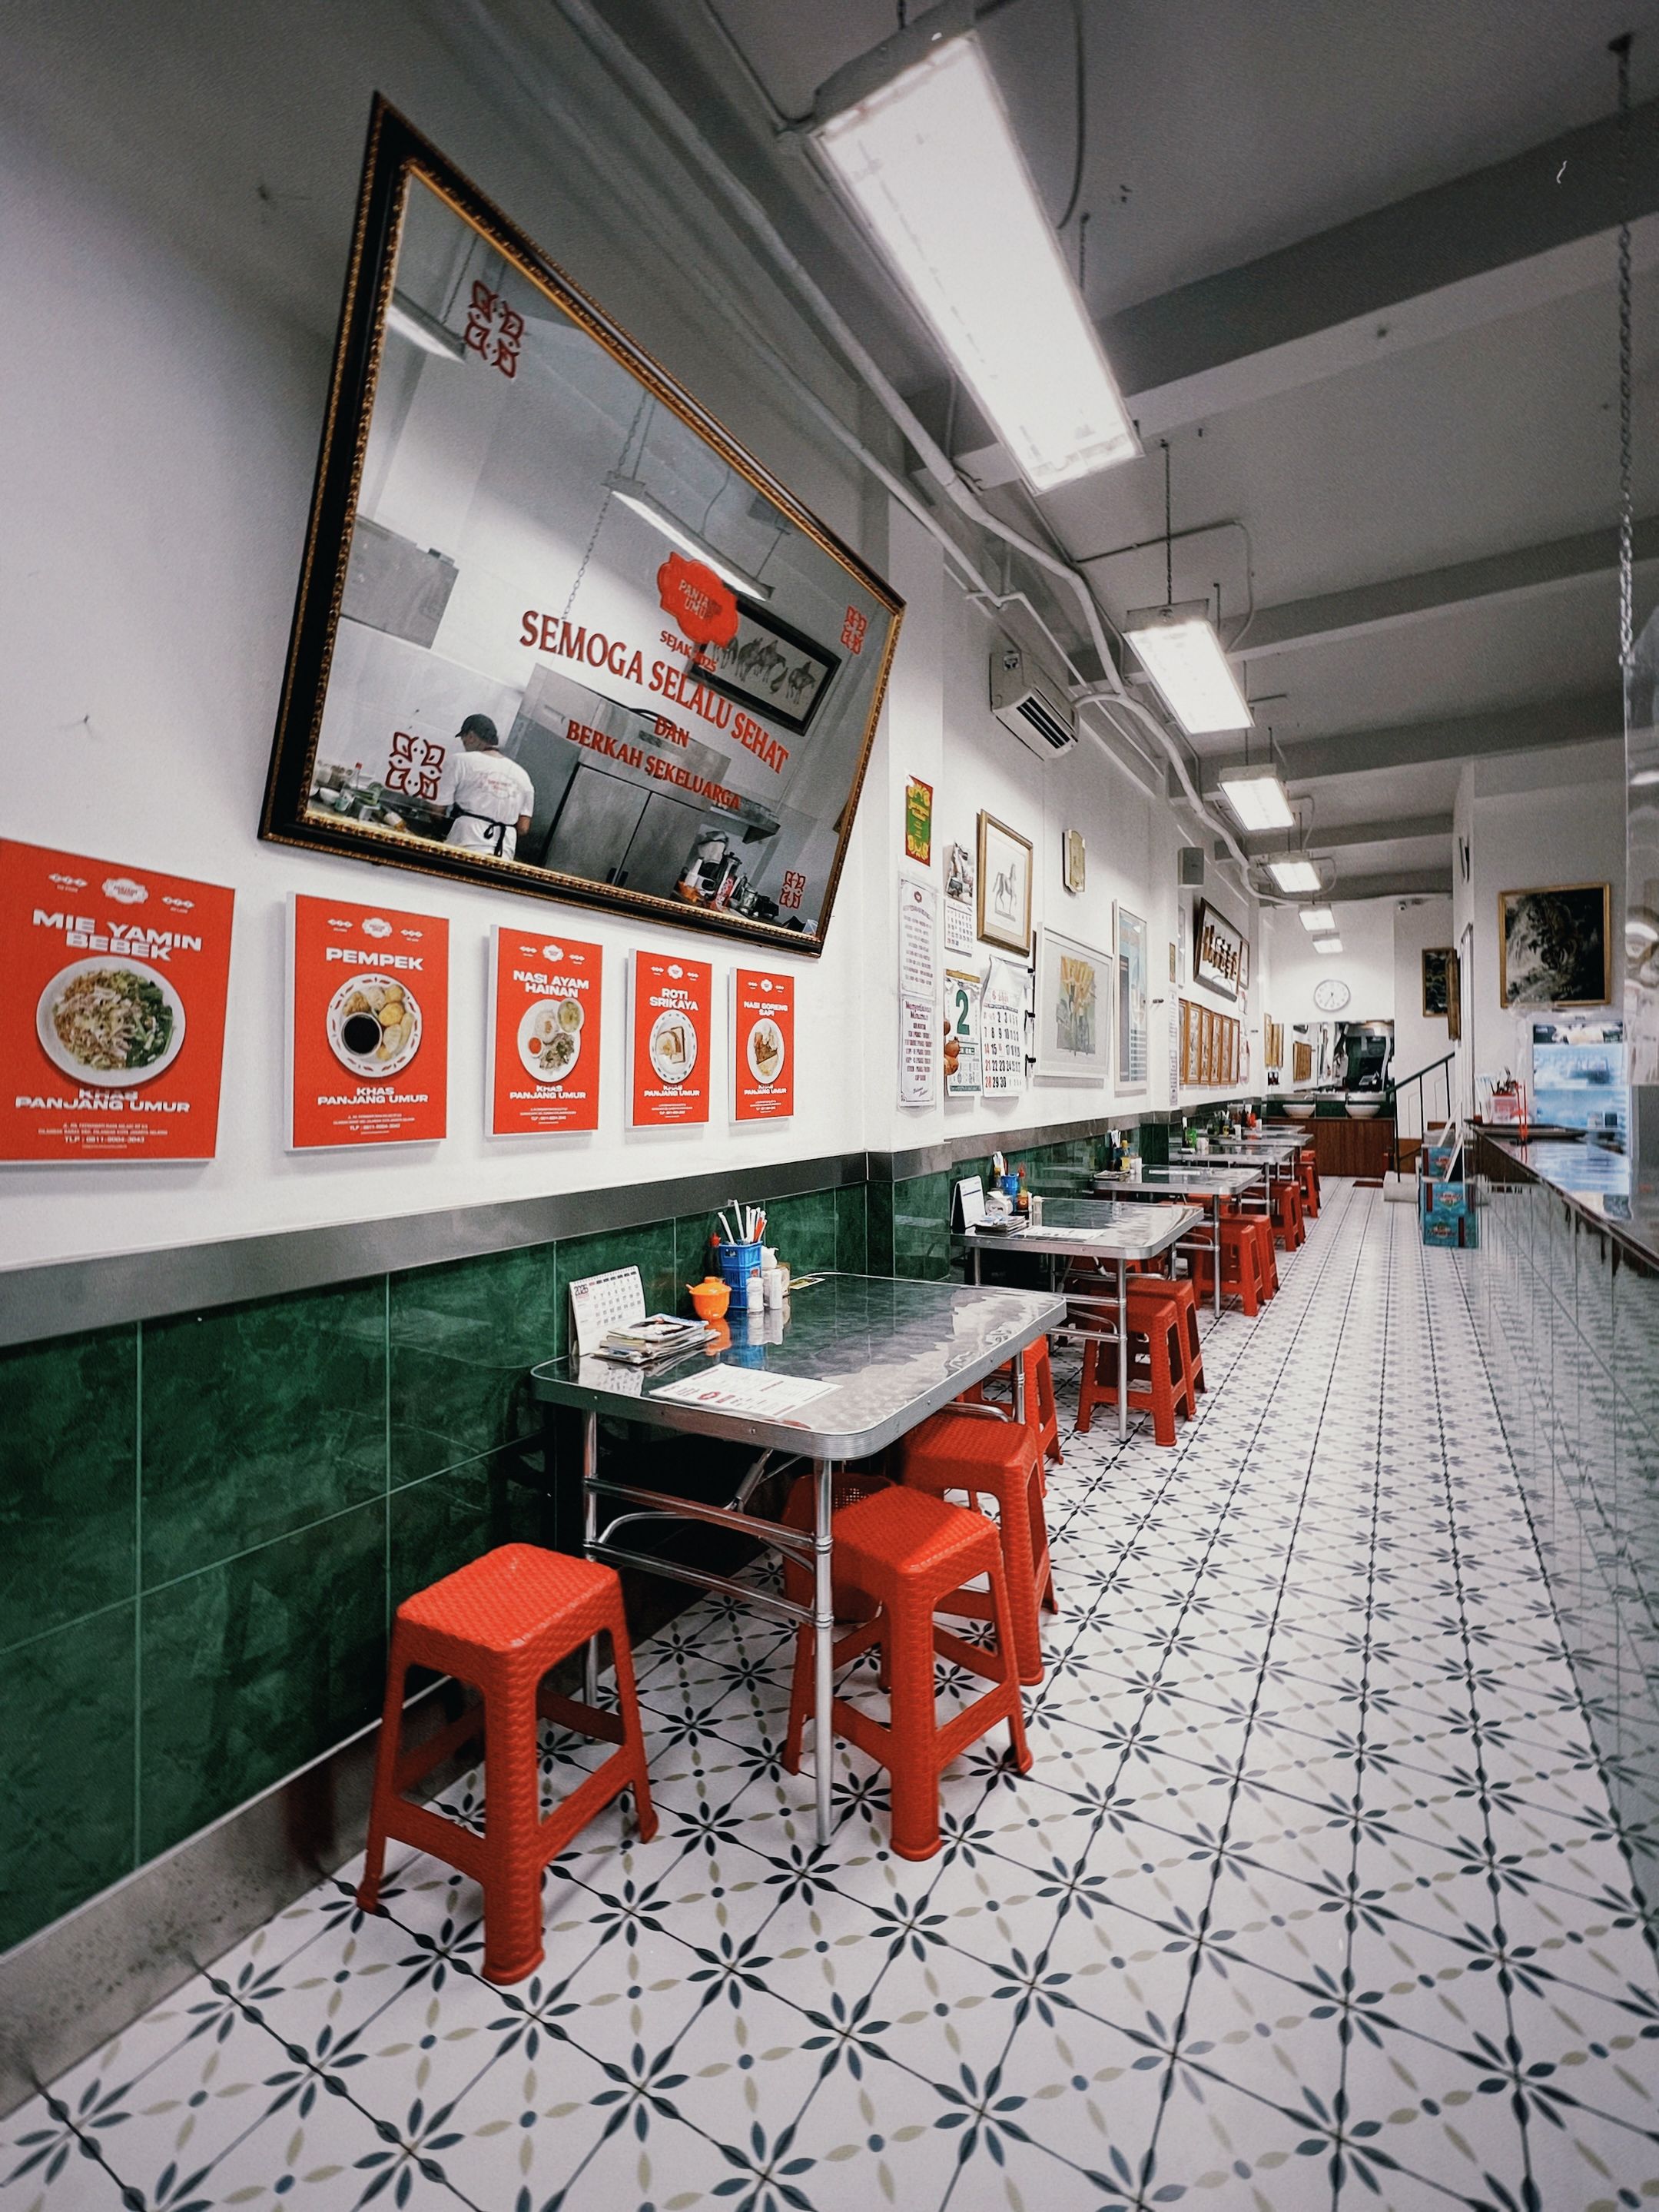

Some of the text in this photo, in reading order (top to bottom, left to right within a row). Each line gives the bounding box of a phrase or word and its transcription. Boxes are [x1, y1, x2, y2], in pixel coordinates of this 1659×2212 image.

[659, 630, 692, 659] SEJAK
[519, 610, 790, 775] SEMOGA SELALU SEHAT
[654, 715, 690, 749] DAN
[566, 719, 742, 810] BERKAH SEKELUARGA
[33, 908, 202, 952] MIE YAMIN
[66, 930, 172, 961] BEBEK
[326, 946, 423, 971] PEMPEK
[513, 970, 589, 990] NASI AYAM
[525, 982, 579, 998] HAINAN
[662, 988, 688, 1000] ROTI
[649, 996, 699, 1011] SRIKAYA
[955, 989, 971, 1036] 2
[992, 1060, 998, 1071] 22
[999, 1060, 1005, 1071] 23
[356, 1087, 395, 1095] KHAS
[993, 1077, 999, 1088] 29
[78, 1088, 138, 1101] KHAS
[317, 1094, 429, 1105] PANJANG UMUR
[15, 1096, 191, 1113] PANJANG UMUR
